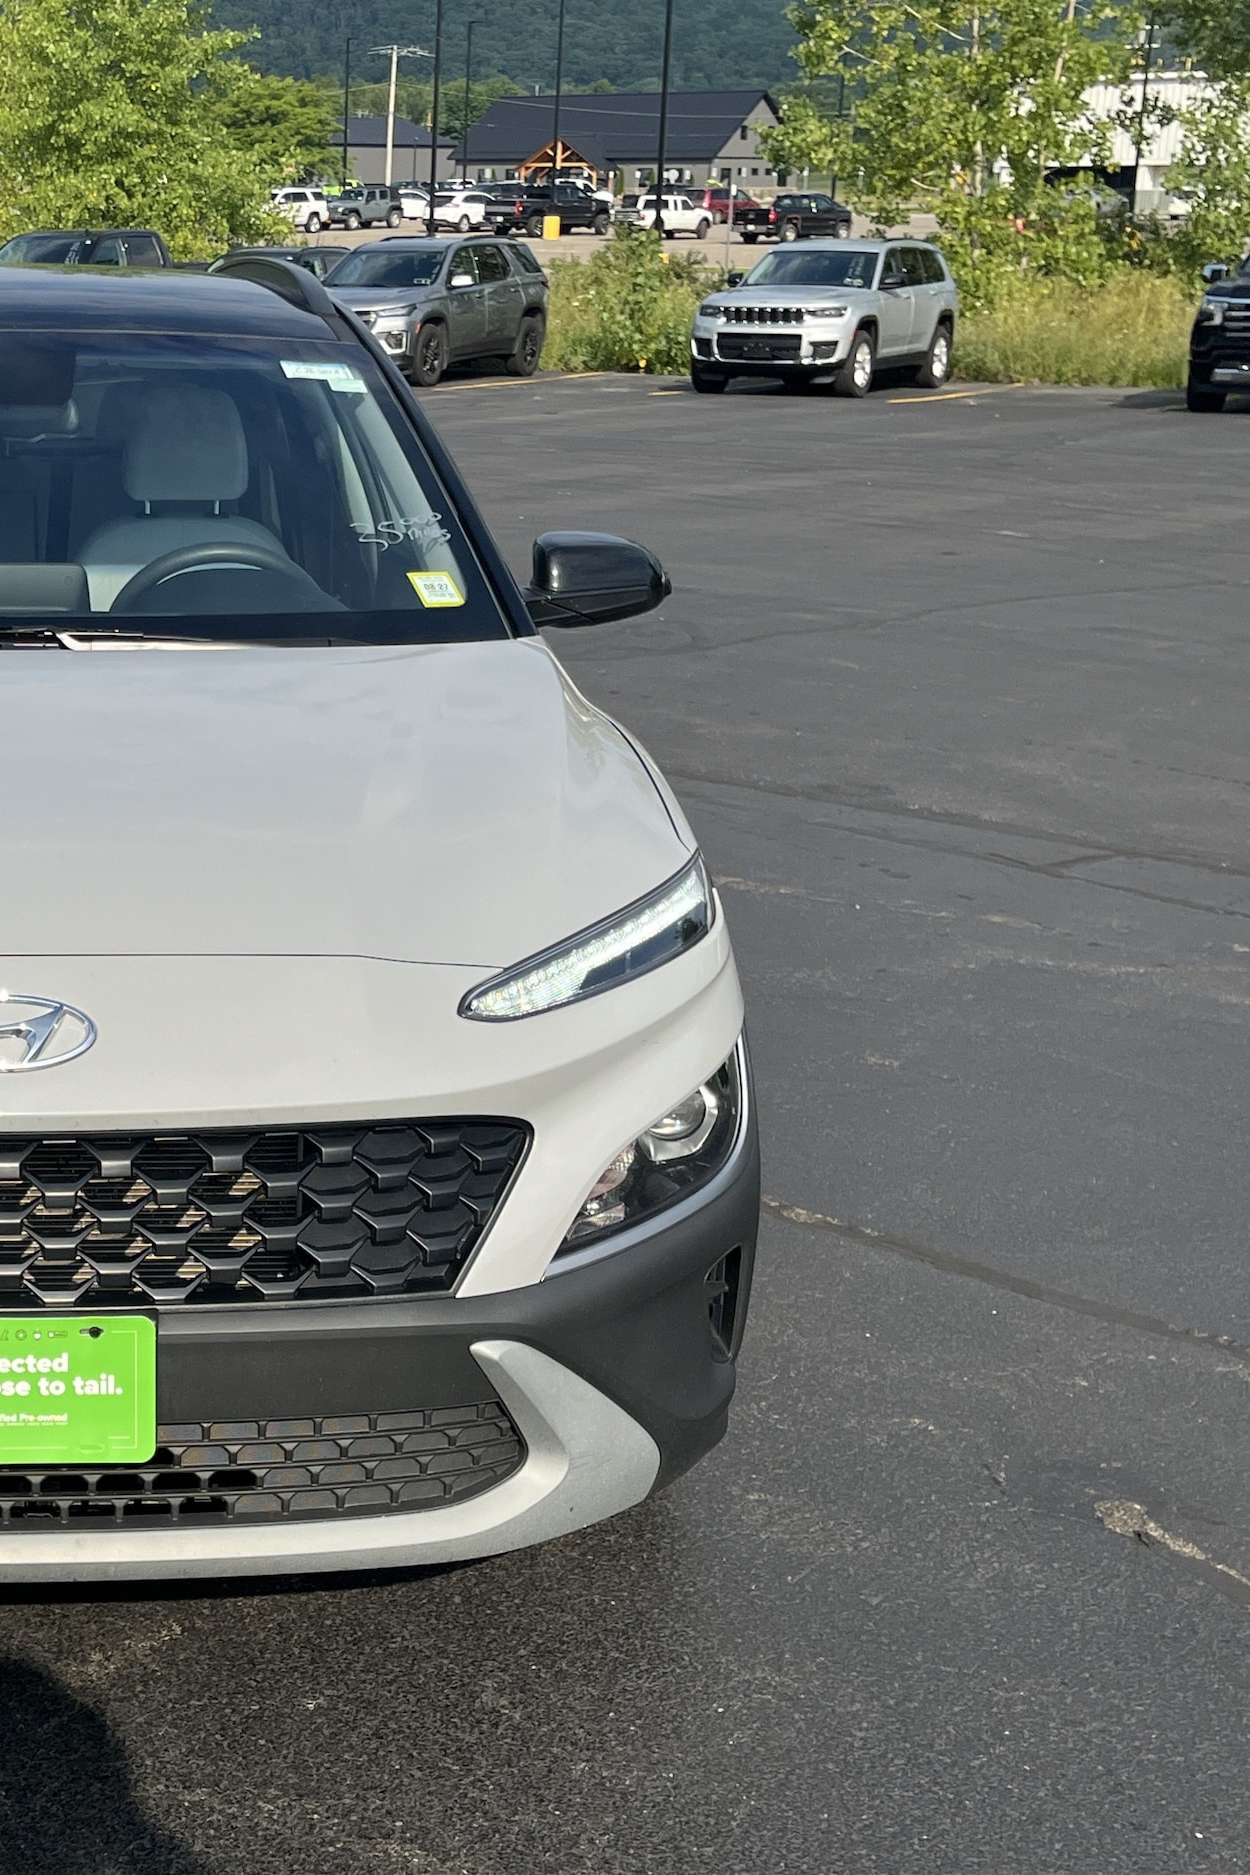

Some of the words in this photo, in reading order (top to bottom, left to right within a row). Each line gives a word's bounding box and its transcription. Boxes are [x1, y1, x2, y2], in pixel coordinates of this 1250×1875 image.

[38, 1377, 66, 1396] to
[73, 1373, 124, 1396] tail.
[19, 1412, 68, 1423] Pre-owned
